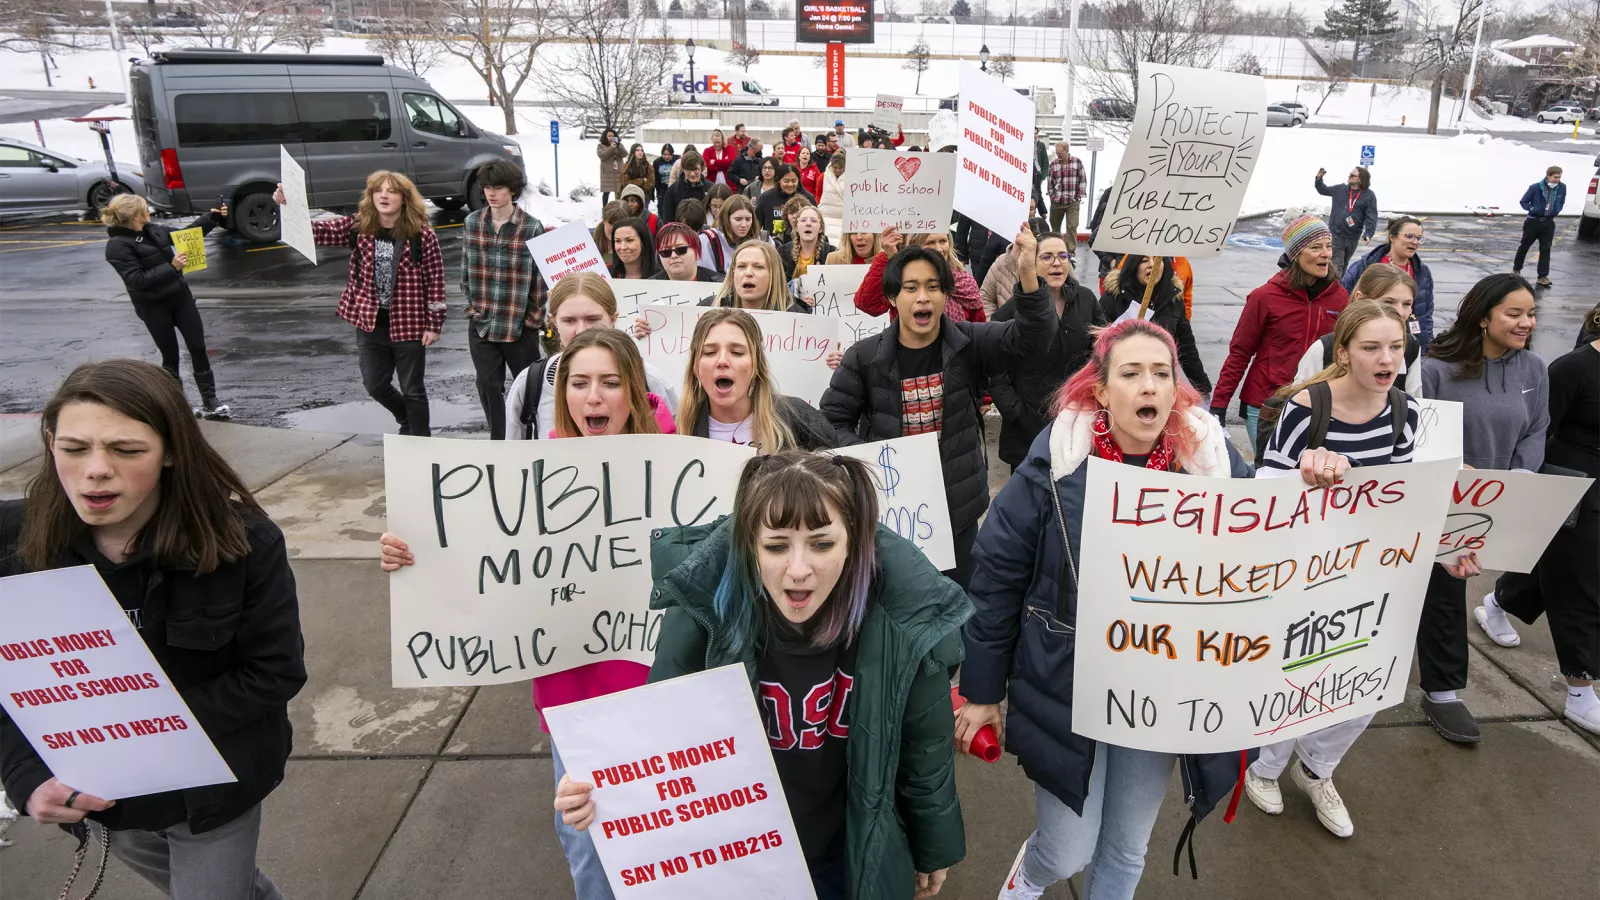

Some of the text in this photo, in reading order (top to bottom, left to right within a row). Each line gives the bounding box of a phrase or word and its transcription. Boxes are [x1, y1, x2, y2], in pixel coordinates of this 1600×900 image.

[804, 5, 867, 14] GIRL'S BASKETBALL
[809, 14, 821, 22] Jan
[830, 15, 837, 23] @
[838, 15, 851, 23] 7:00
[834, 23, 855, 31] Game!
[672, 74, 733, 94] FedEx
[968, 100, 1025, 143] PUBLIC MONEY
[1145, 72, 1260, 141] PROTECT
[963, 126, 993, 153] PUBLIC
[993, 144, 1029, 175] SCHOOLS
[990, 127, 1006, 146] FOR
[857, 152, 876, 174] I
[1177, 144, 1223, 173] YOUR
[849, 178, 941, 198] public school
[962, 157, 1026, 204] SAY NO TO HB215
[1112, 169, 1216, 215] PUBLIC
[849, 219, 871, 231] NO
[916, 220, 937, 231] 215
[850, 202, 921, 216] teachers.
[1109, 216, 1232, 252] SCHOOLS!
[545, 242, 587, 265] PUBLIC MONEY
[564, 256, 577, 267] FOR
[571, 257, 600, 273] SCHOOLS
[430, 458, 718, 549] PUBLIC
[1111, 480, 1405, 537] LEGISLATORS
[478, 534, 643, 595] MONE
[1121, 531, 1421, 598] WALKED OUT ON
[549, 582, 586, 607] FOR
[0, 629, 117, 661] UBLIC MONEY
[406, 610, 664, 680] PUBLIC SCHO
[1105, 592, 1391, 667] OUR KIDS FIRST!
[50, 658, 91, 678] FOR
[10, 672, 160, 709] PUBLIC SCHOOLS
[1106, 655, 1398, 734] NO TO VOUCHERS!
[42, 715, 188, 750] SAY NO TO HB215
[591, 736, 738, 789] PUBLIC MONEY
[655, 776, 698, 802] FOR
[601, 782, 768, 840] PUBLIC SCHOOLS
[620, 829, 784, 888] SAY NO TO HB215
